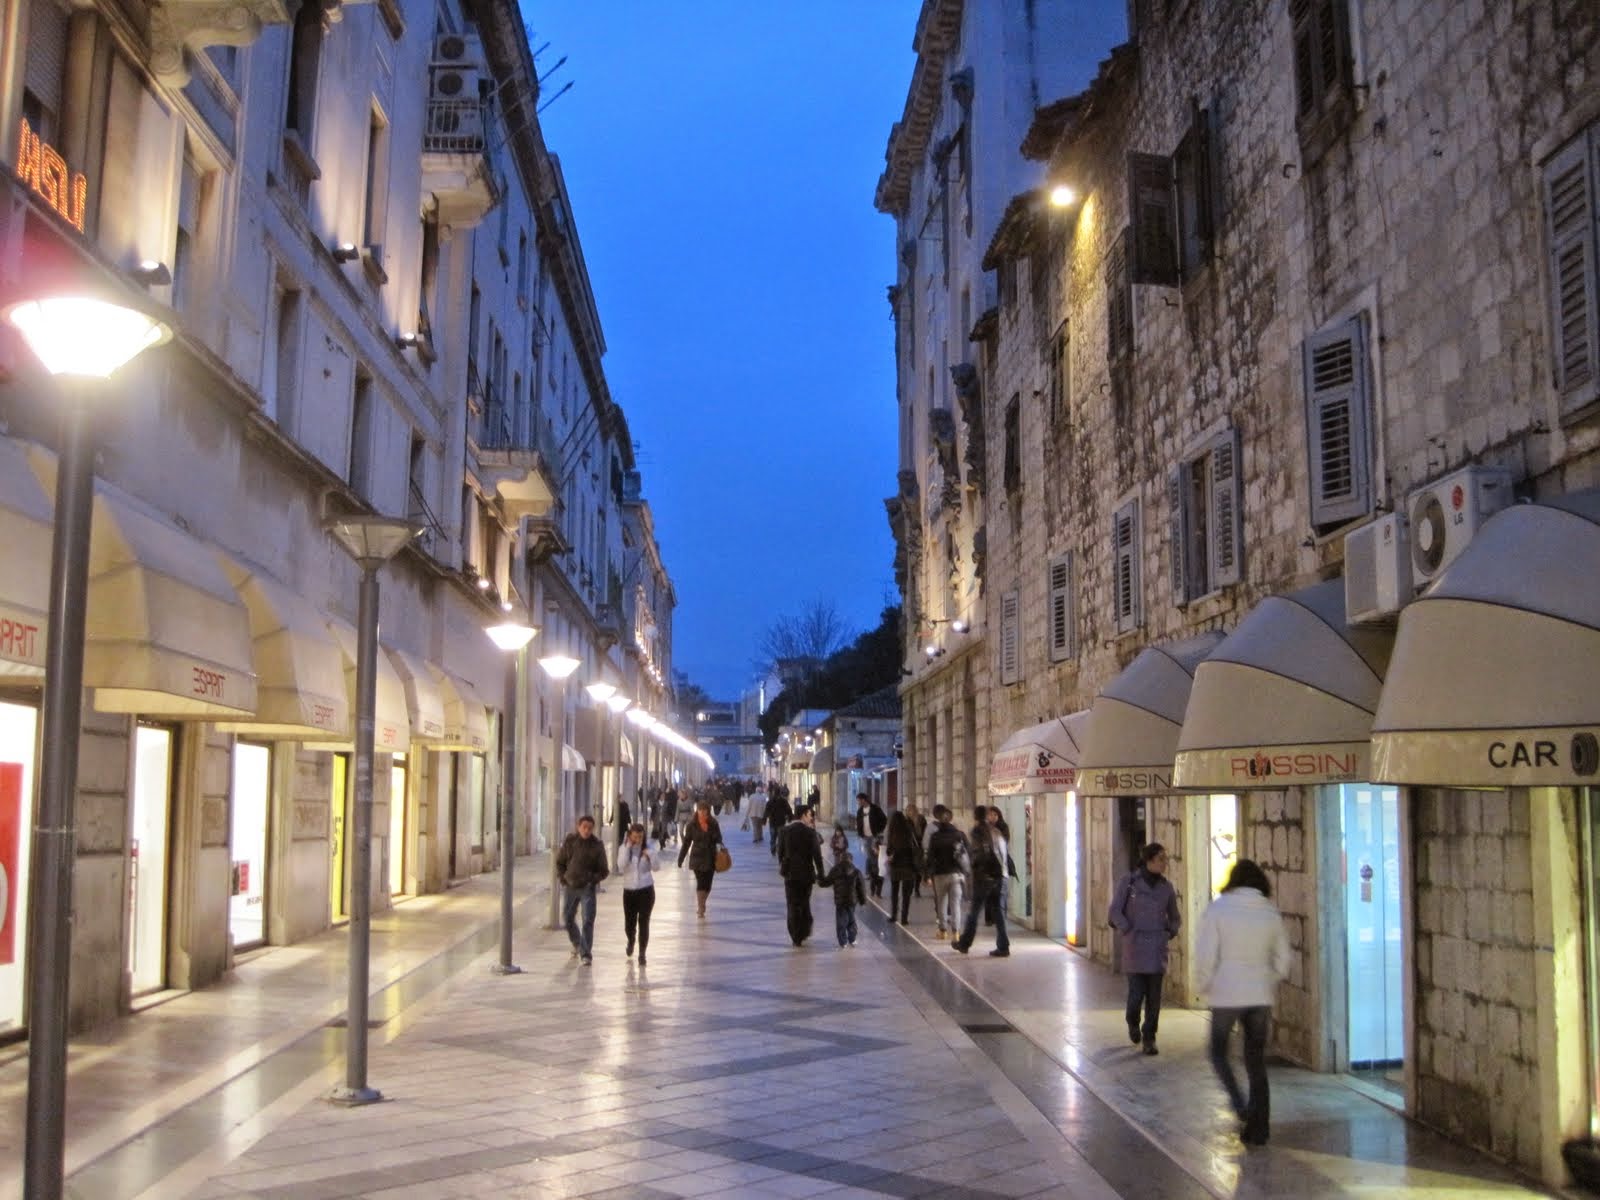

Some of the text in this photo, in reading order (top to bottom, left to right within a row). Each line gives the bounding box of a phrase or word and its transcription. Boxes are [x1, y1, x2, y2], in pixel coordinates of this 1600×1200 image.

[1454, 512, 1464, 526] LG
[0, 617, 38, 657] PRIT
[192, 666, 226, 699] ESPRIT
[1231, 750, 1357, 782] ROSSINI
[1487, 740, 1560, 769] CAR
[1043, 776, 1074, 785] MONEY
